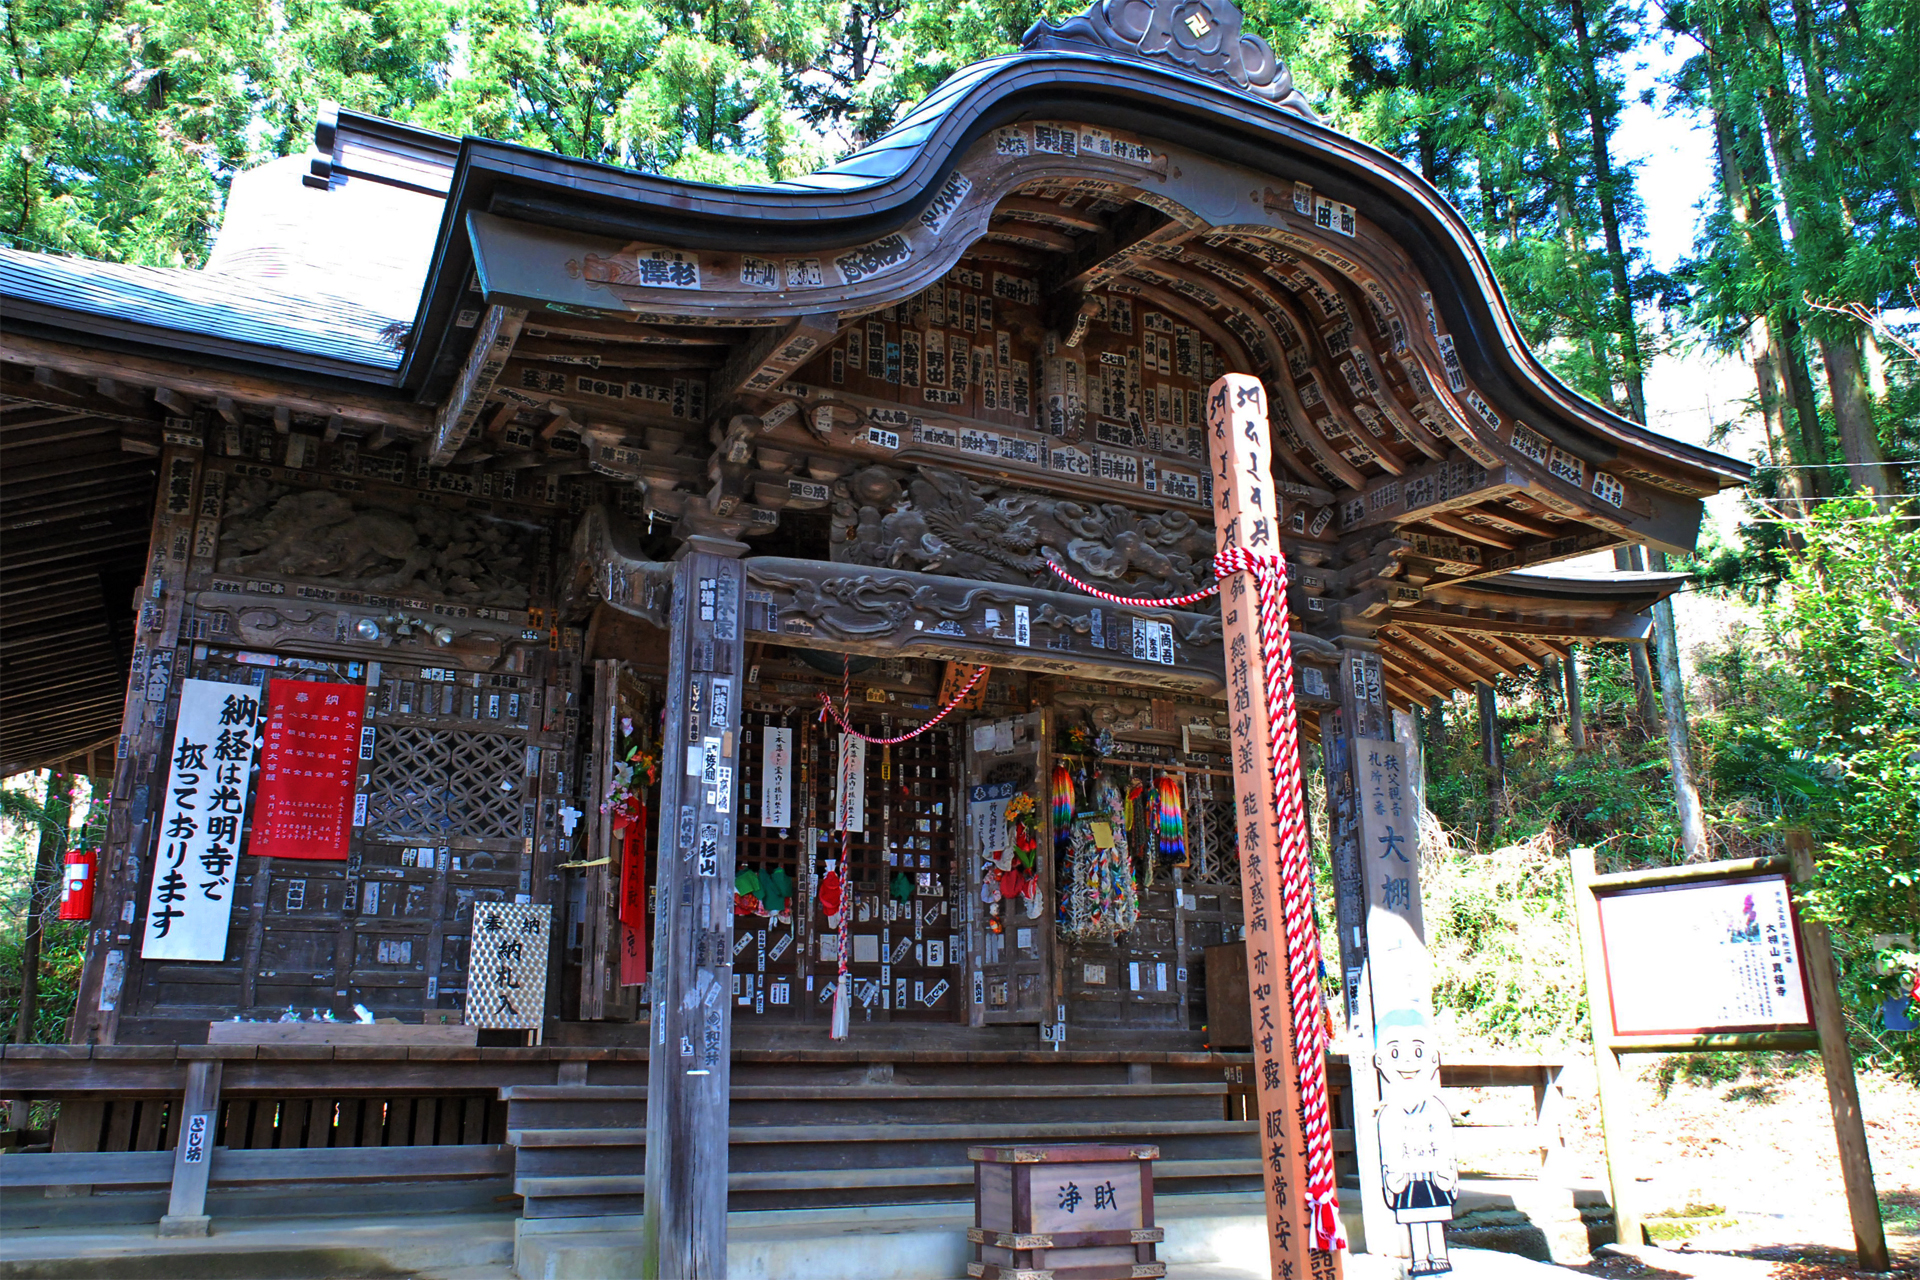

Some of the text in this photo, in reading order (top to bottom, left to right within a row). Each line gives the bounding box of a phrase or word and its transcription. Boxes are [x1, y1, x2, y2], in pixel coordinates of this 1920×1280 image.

[869, 331, 885, 377] 豊田勝
[952, 350, 968, 392] 伝兵衛
[870, 430, 896, 448] 増田
[1101, 459, 1136, 482] 竹寿司
[1549, 459, 1582, 485] 大久保
[701, 590, 715, 621] 増田
[705, 754, 716, 781] 佐久間
[1368, 750, 1387, 816] 札所二番
[199, 694, 258, 901] 納経は光明寺で
[152, 737, 208, 939] 扱っております
[681, 818, 694, 846] 竹中
[699, 841, 717, 876] 杉山
[485, 915, 541, 934] 奉納
[494, 939, 523, 1015] 納札入
[1253, 950, 1281, 1090] 亦如天甘露
[705, 1031, 720, 1066] 和久井
[1058, 1180, 1118, 1214] 浄財
